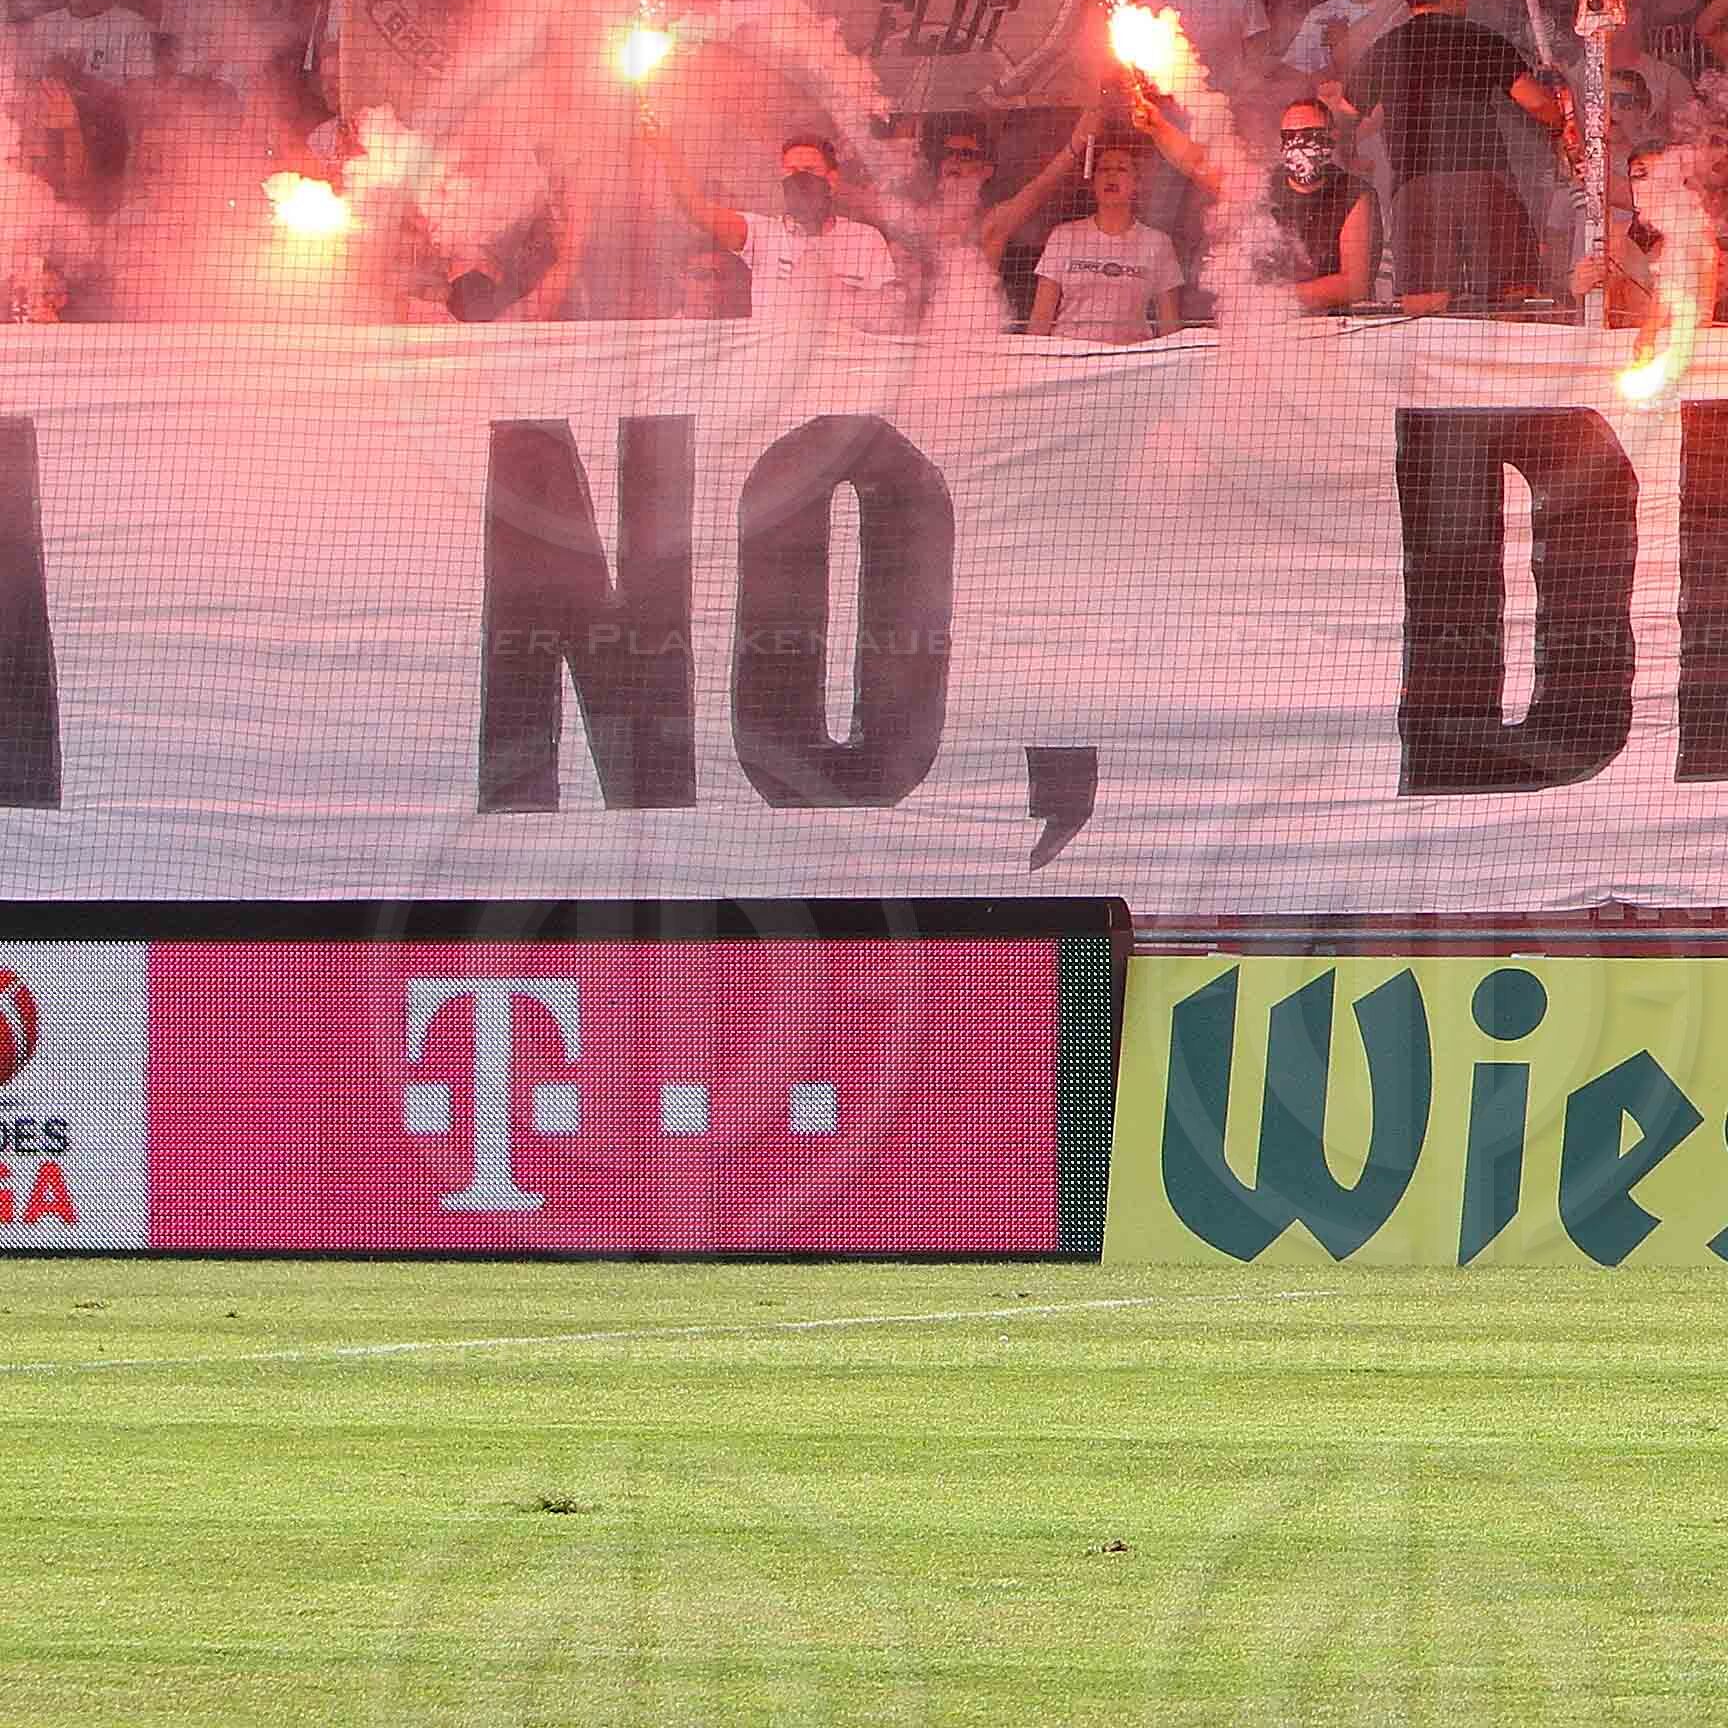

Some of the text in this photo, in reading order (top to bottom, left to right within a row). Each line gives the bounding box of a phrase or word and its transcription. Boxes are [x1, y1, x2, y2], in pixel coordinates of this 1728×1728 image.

[478, 413, 1099, 872] NO,
[0, 1116, 70, 1153] ES
[0, 1158, 80, 1226] A
